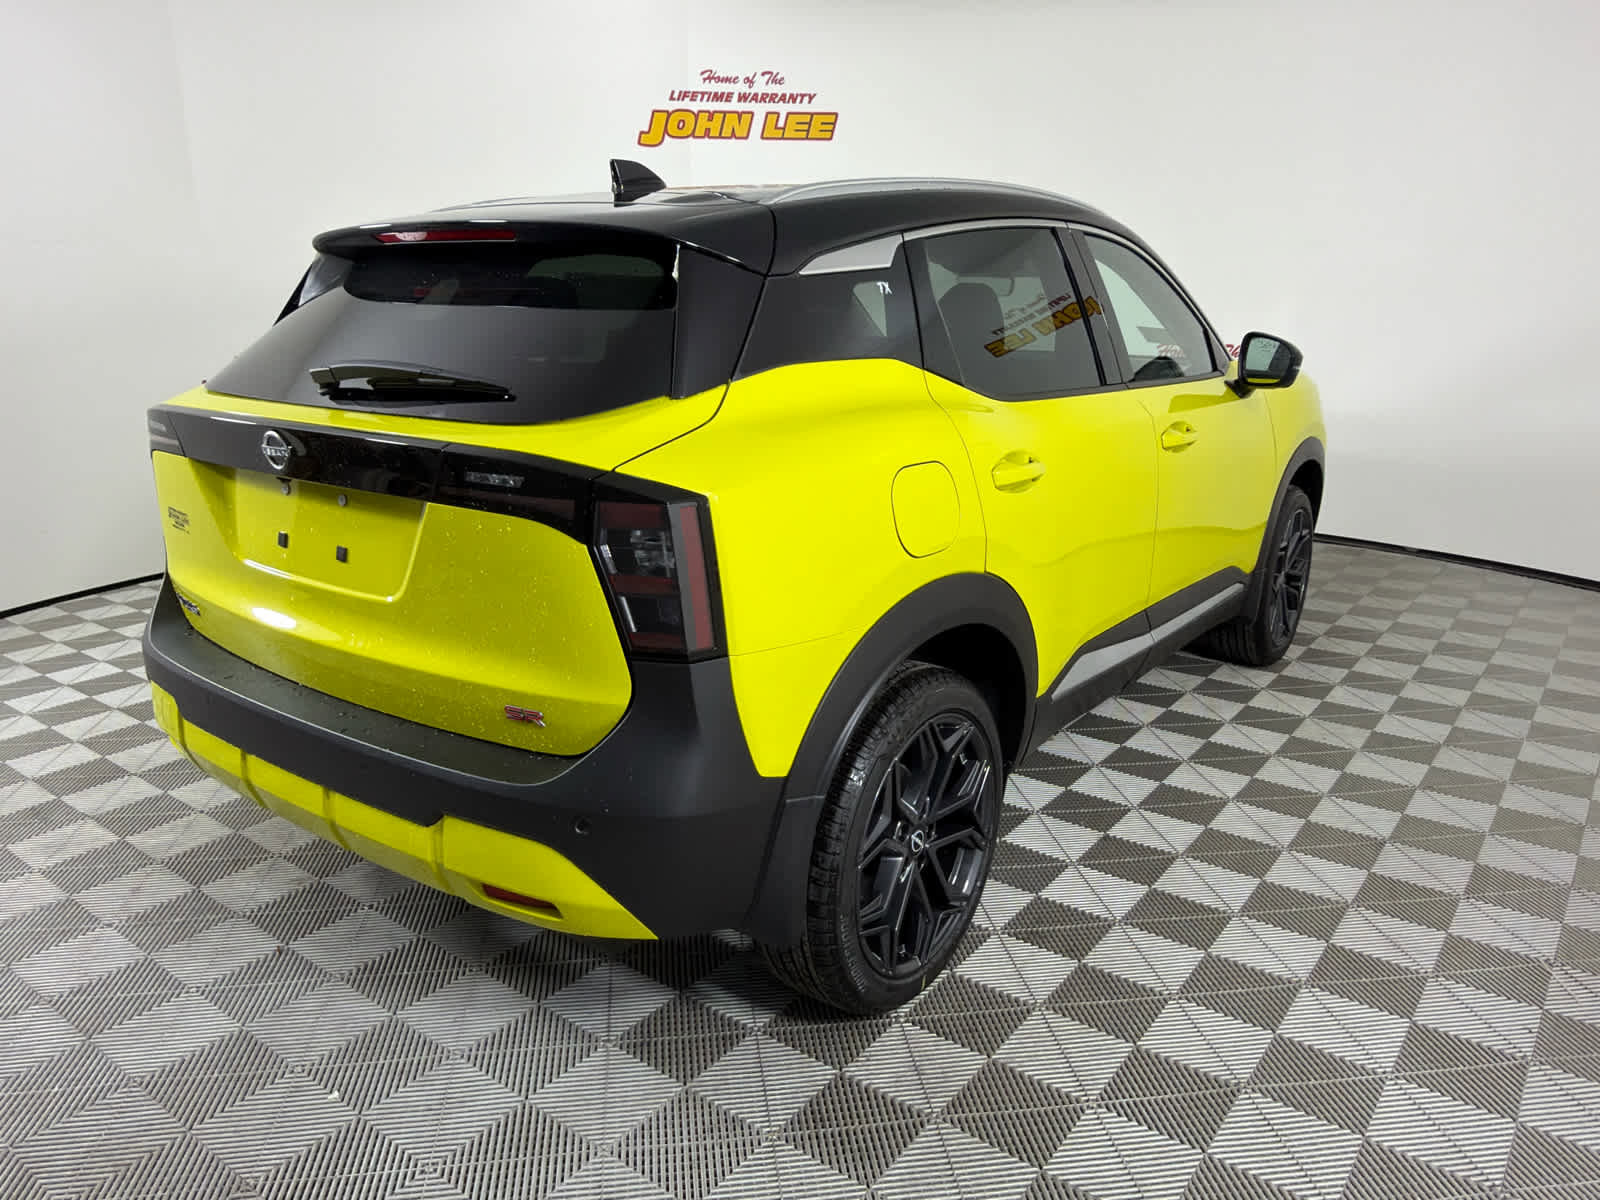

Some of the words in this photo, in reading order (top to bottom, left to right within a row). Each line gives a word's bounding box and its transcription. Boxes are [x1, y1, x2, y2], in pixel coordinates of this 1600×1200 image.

[700, 69, 739, 84] Home
[743, 73, 757, 89] of
[761, 71, 785, 85] The
[669, 90, 734, 103] LIFETIME
[737, 92, 816, 104] WARRANTY
[638, 109, 753, 147] JOHN
[761, 111, 838, 141] LEE
[876, 281, 893, 295] TX
[504, 704, 546, 727] SR
